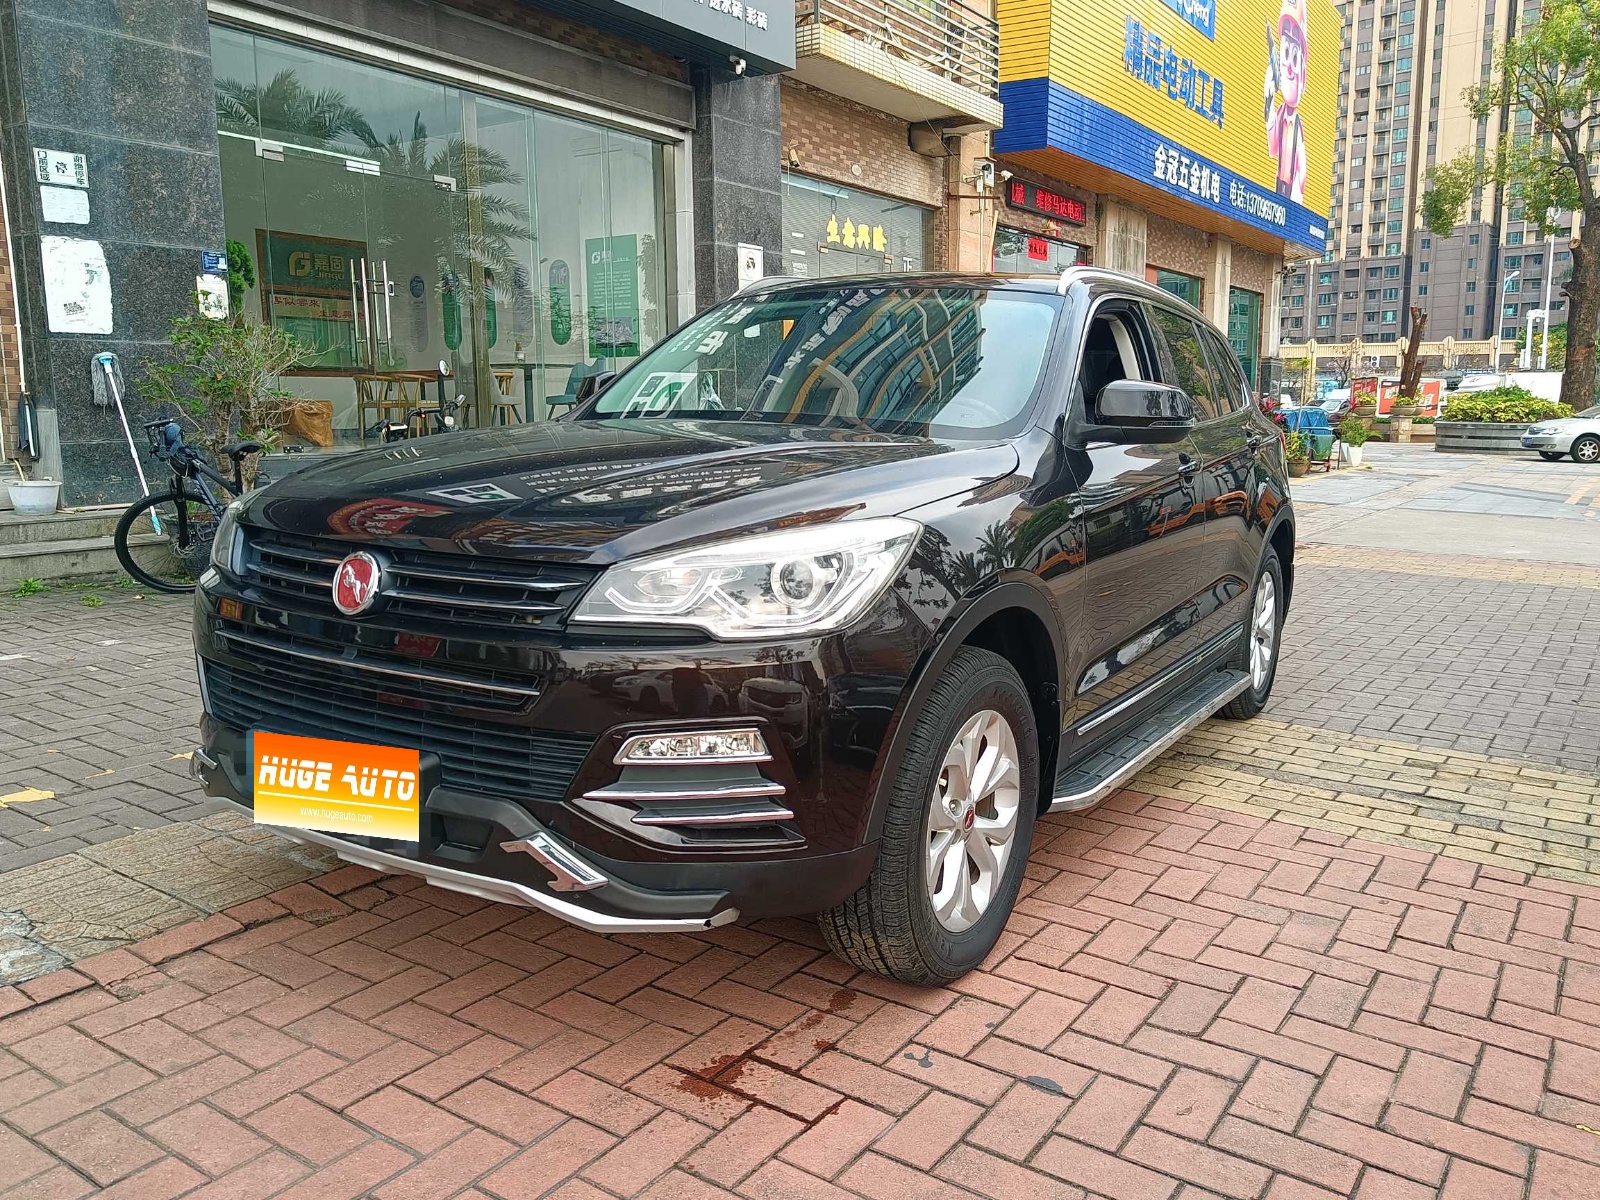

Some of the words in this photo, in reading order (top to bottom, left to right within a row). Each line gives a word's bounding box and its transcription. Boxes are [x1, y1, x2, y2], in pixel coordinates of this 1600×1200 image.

[1122, 14, 1225, 130] 精品电动工具
[1153, 143, 1221, 203] 金冠五金机电
